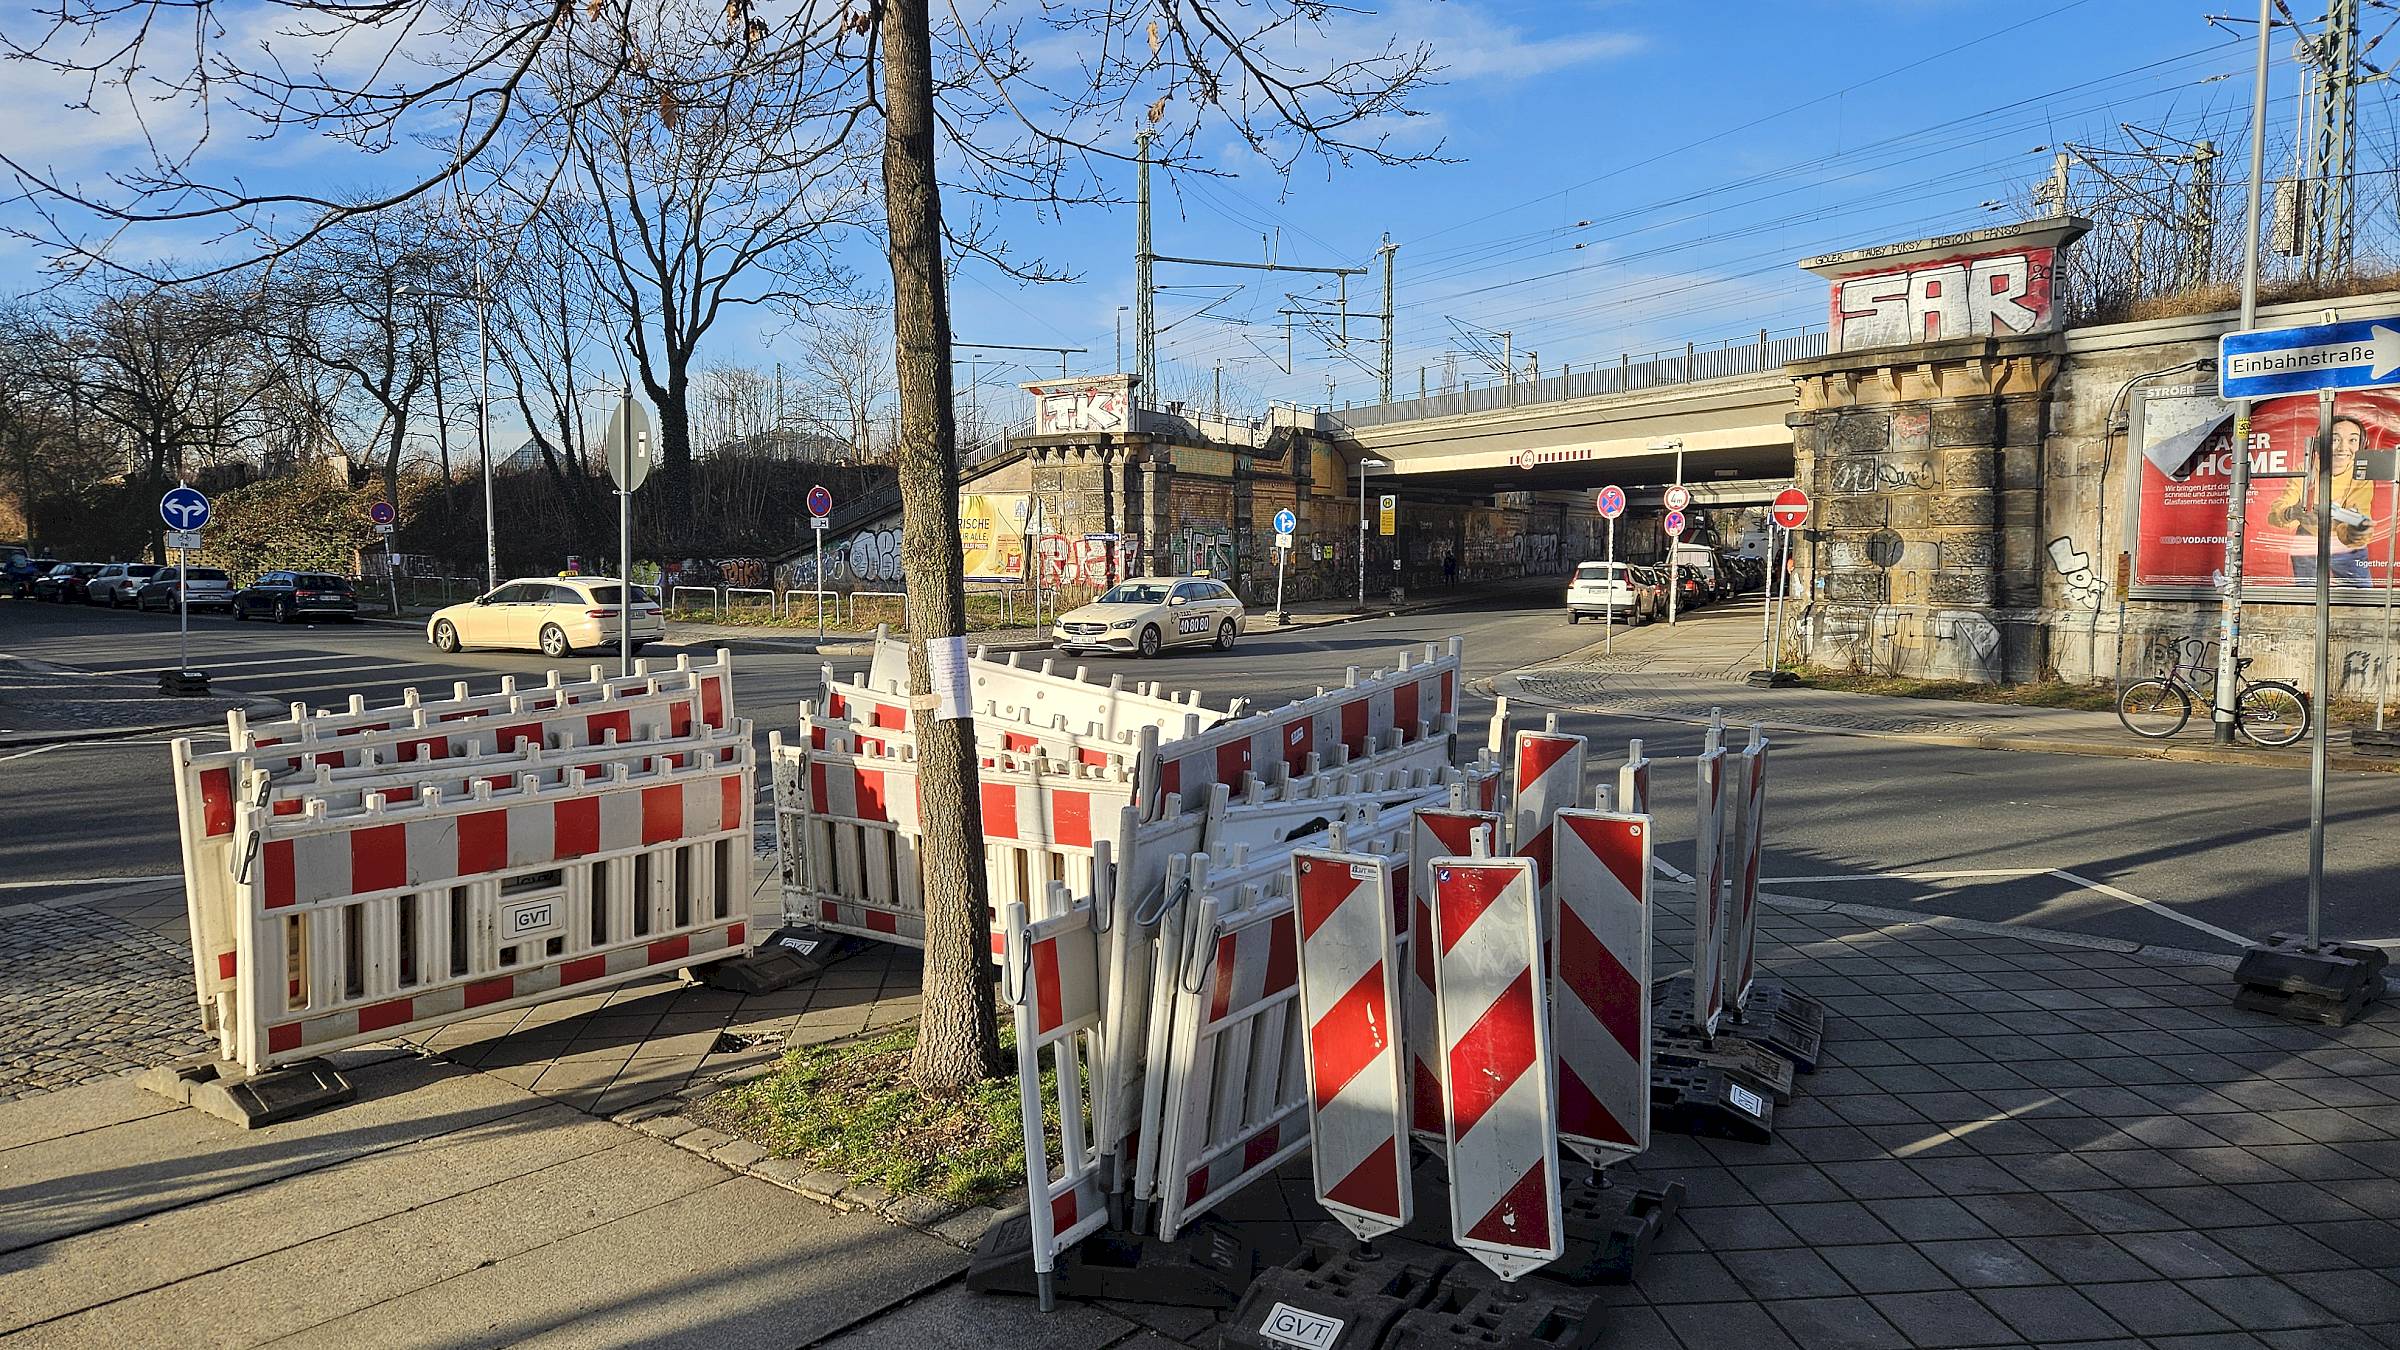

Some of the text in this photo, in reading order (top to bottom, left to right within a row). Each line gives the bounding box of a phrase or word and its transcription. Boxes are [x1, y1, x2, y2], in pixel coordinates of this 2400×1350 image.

[1931, 232, 1974, 248] FUSION
[1840, 255, 2038, 352] SAR
[2233, 346, 2375, 373] Einbahnstraße
[2176, 484, 2201, 492] bringen
[2201, 484, 2217, 492] jetzt
[957, 518, 990, 530] RISCHE
[2354, 559, 2389, 568] Together
[1179, 616, 1209, 633] 40 80 80
[519, 909, 548, 926] GVT
[1275, 1314, 1331, 1341] GVT
